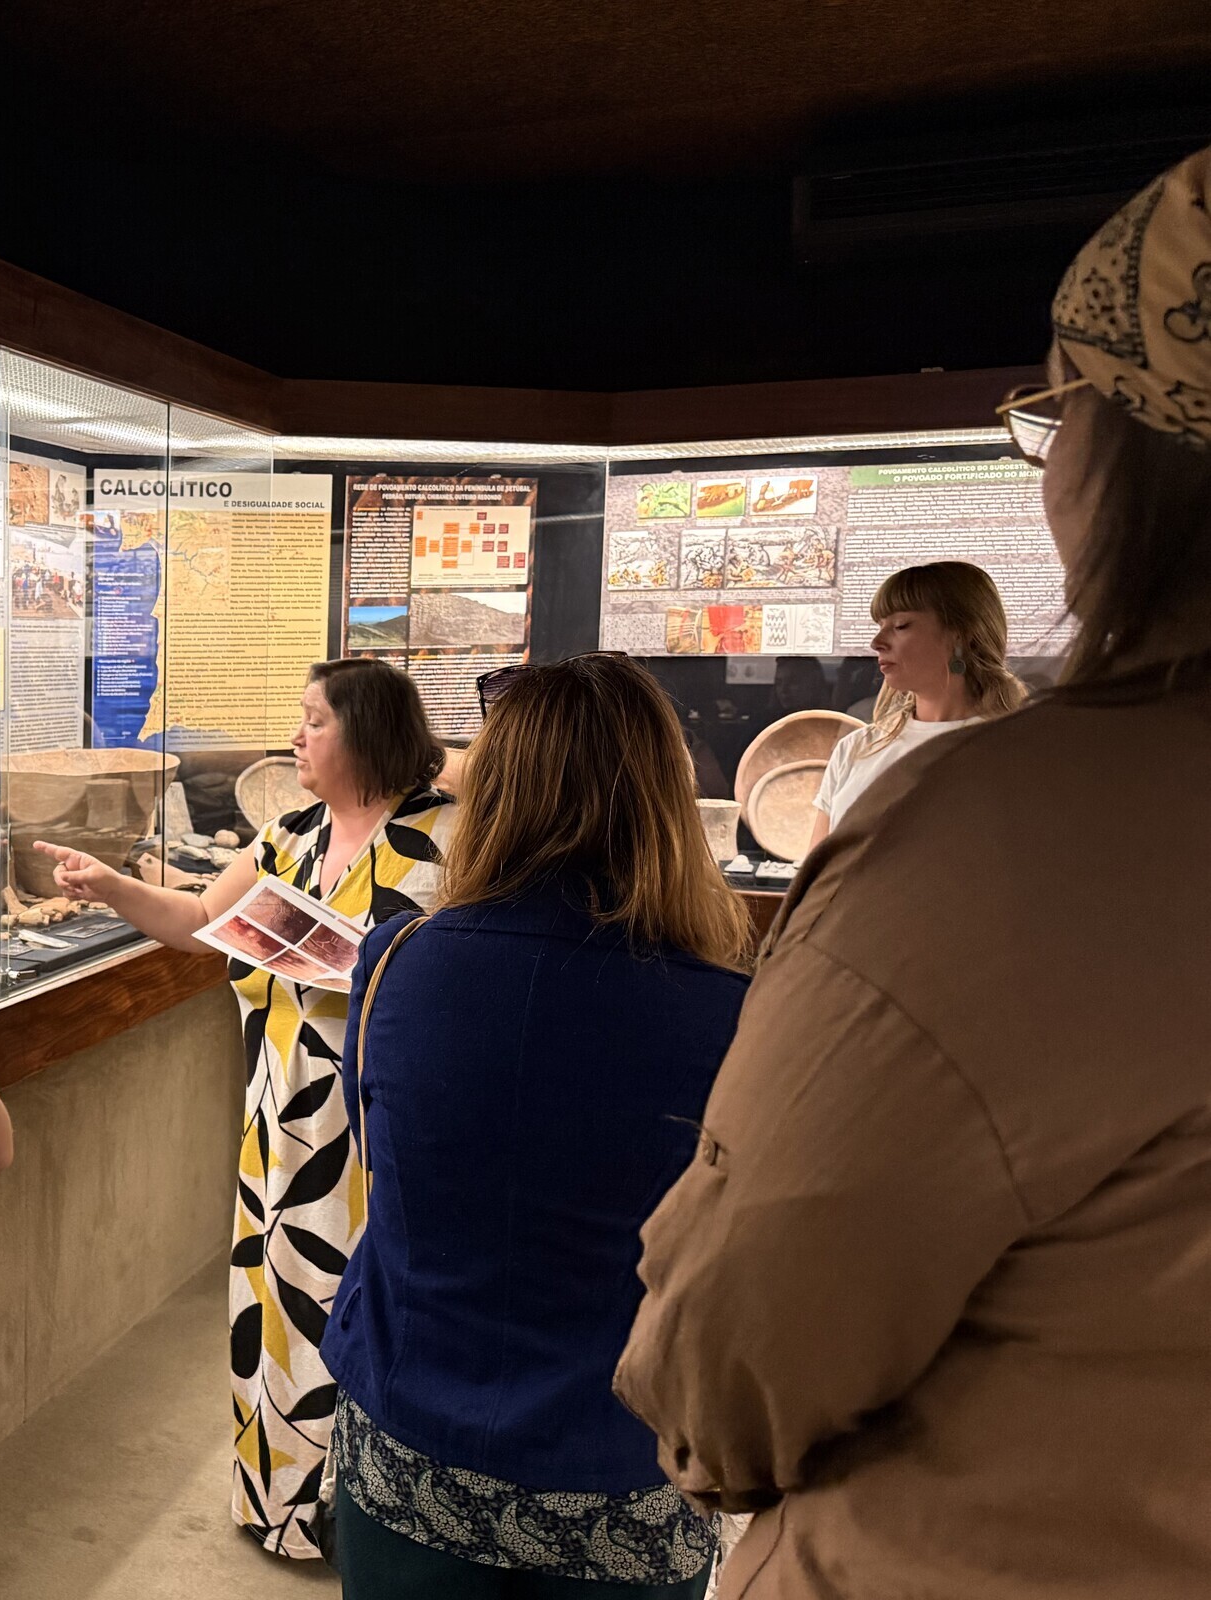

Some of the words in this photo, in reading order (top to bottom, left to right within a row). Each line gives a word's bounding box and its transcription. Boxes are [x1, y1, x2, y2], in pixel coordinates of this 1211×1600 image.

[945, 472, 1002, 480] FORTIFICADO
[100, 478, 232, 498] CALCOLÍTICO
[295, 501, 325, 509] SOCIAL
